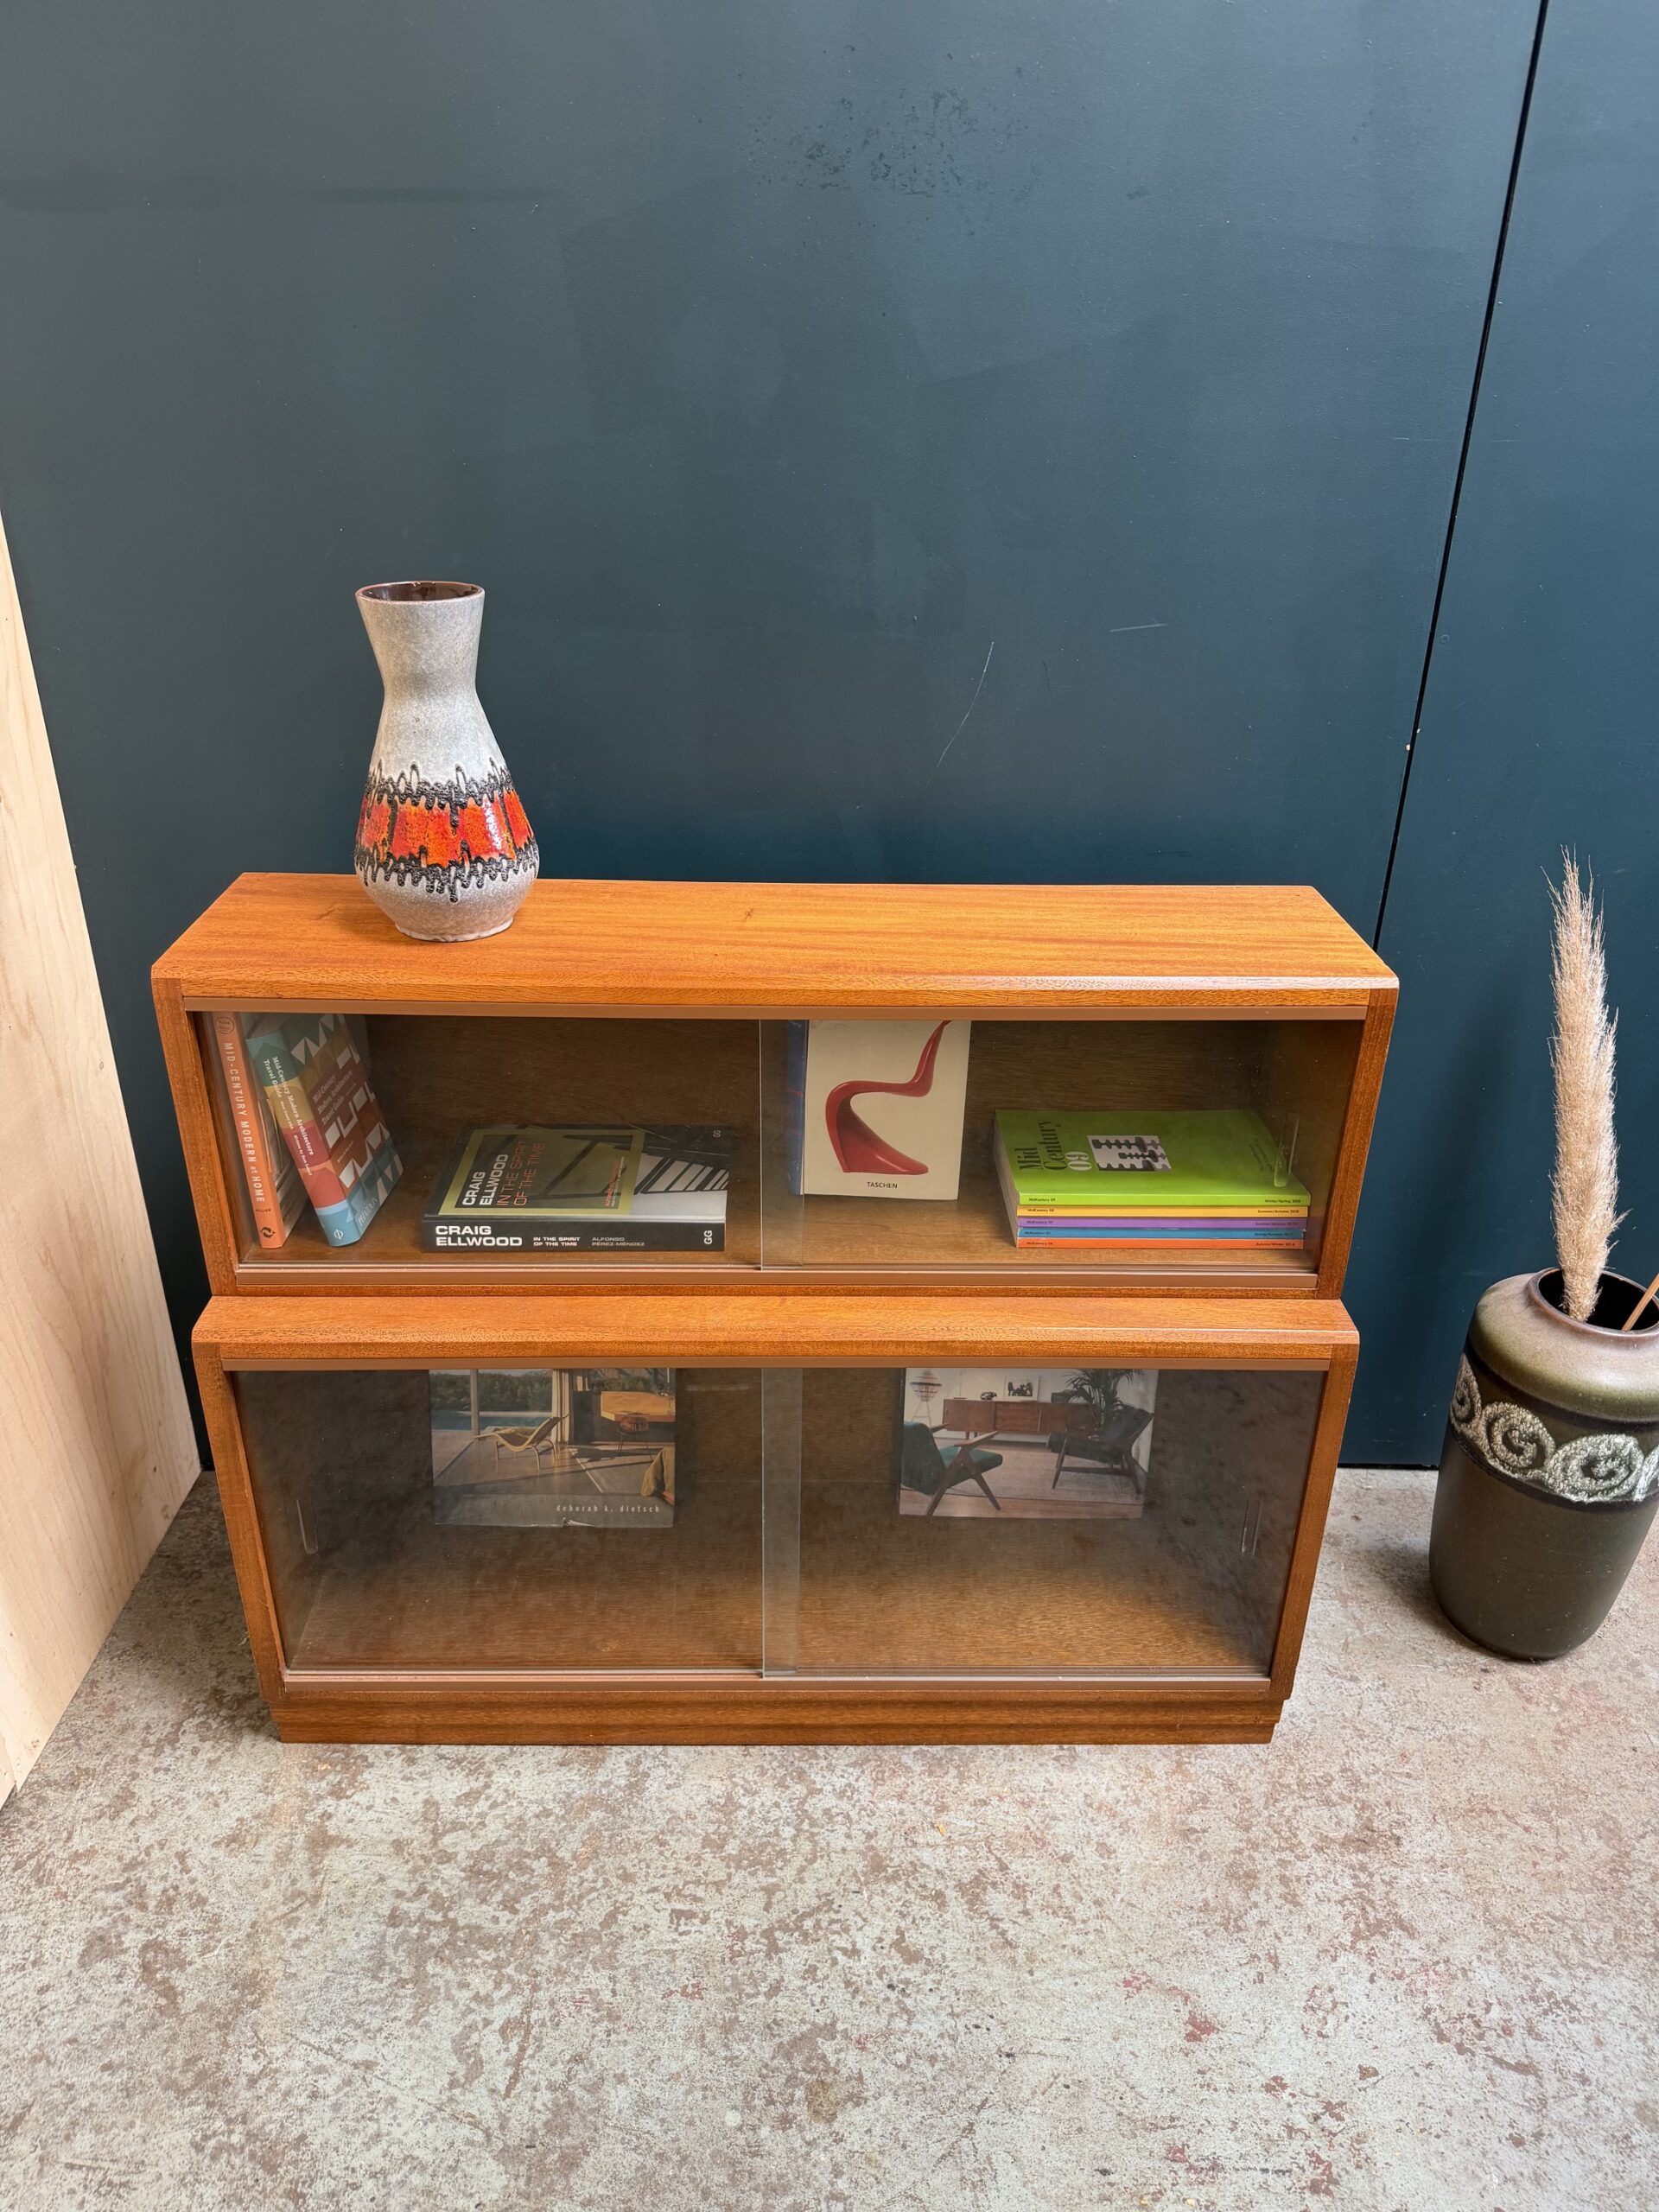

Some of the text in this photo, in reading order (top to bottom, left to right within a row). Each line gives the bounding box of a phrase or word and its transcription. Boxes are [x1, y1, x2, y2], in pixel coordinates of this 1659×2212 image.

[264, 1058, 276, 1079] Travel
[223, 1042, 249, 1116] MID-CENTURY
[240, 1121, 257, 1163] MODERN
[251, 1176, 265, 1202] HOME
[272, 1056, 315, 1155] Mid-Century Modern Architecture
[1014, 1147, 1044, 1171] Mid
[1037, 1121, 1068, 1171] Century
[1065, 1151, 1092, 1172] 09
[461, 1171, 486, 1206] CRAIG
[479, 1154, 509, 1206] ELLWOOD
[496, 1138, 527, 1205] IN THE SPIRIT
[513, 1142, 545, 1206] OF THE TIME
[435, 1225, 493, 1236] CRAIG
[435, 1236, 523, 1247] ELLWOOD
[703, 1230, 714, 1245] GG
